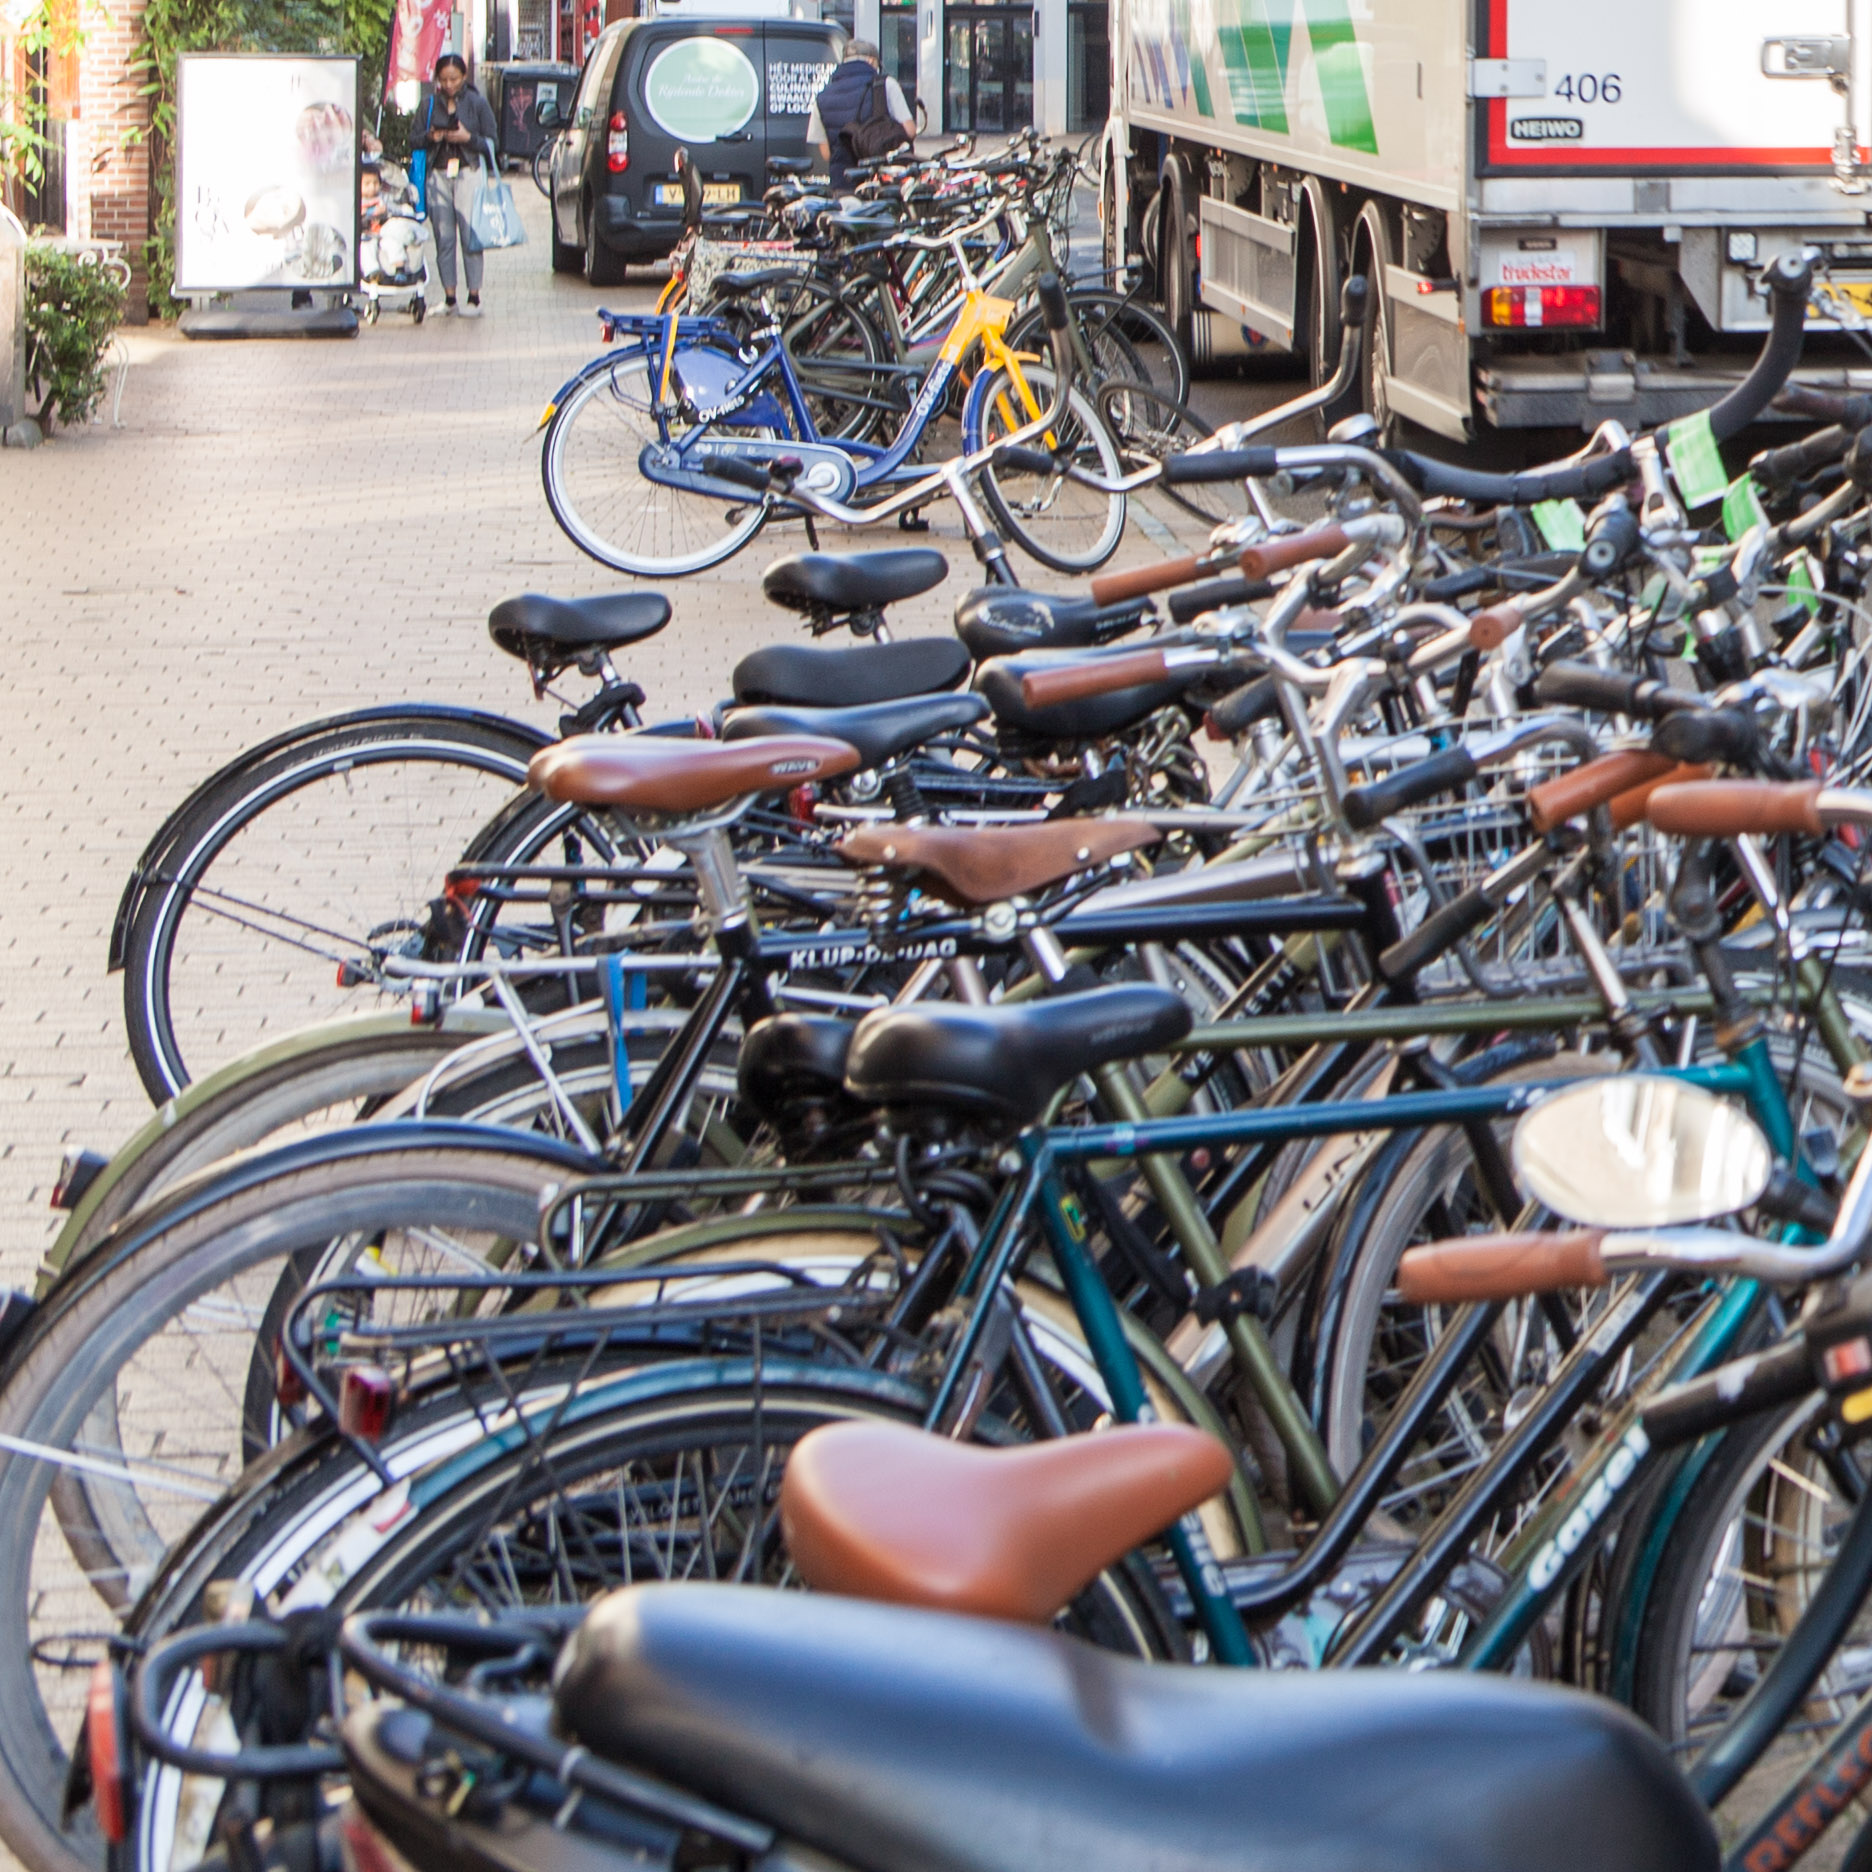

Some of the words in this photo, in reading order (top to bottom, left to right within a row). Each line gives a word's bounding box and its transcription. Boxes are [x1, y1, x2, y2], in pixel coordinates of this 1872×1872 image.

[1554, 72, 1622, 104] 406
[771, 760, 818, 775] WAVE
[1528, 1423, 1651, 1593] Gazel
